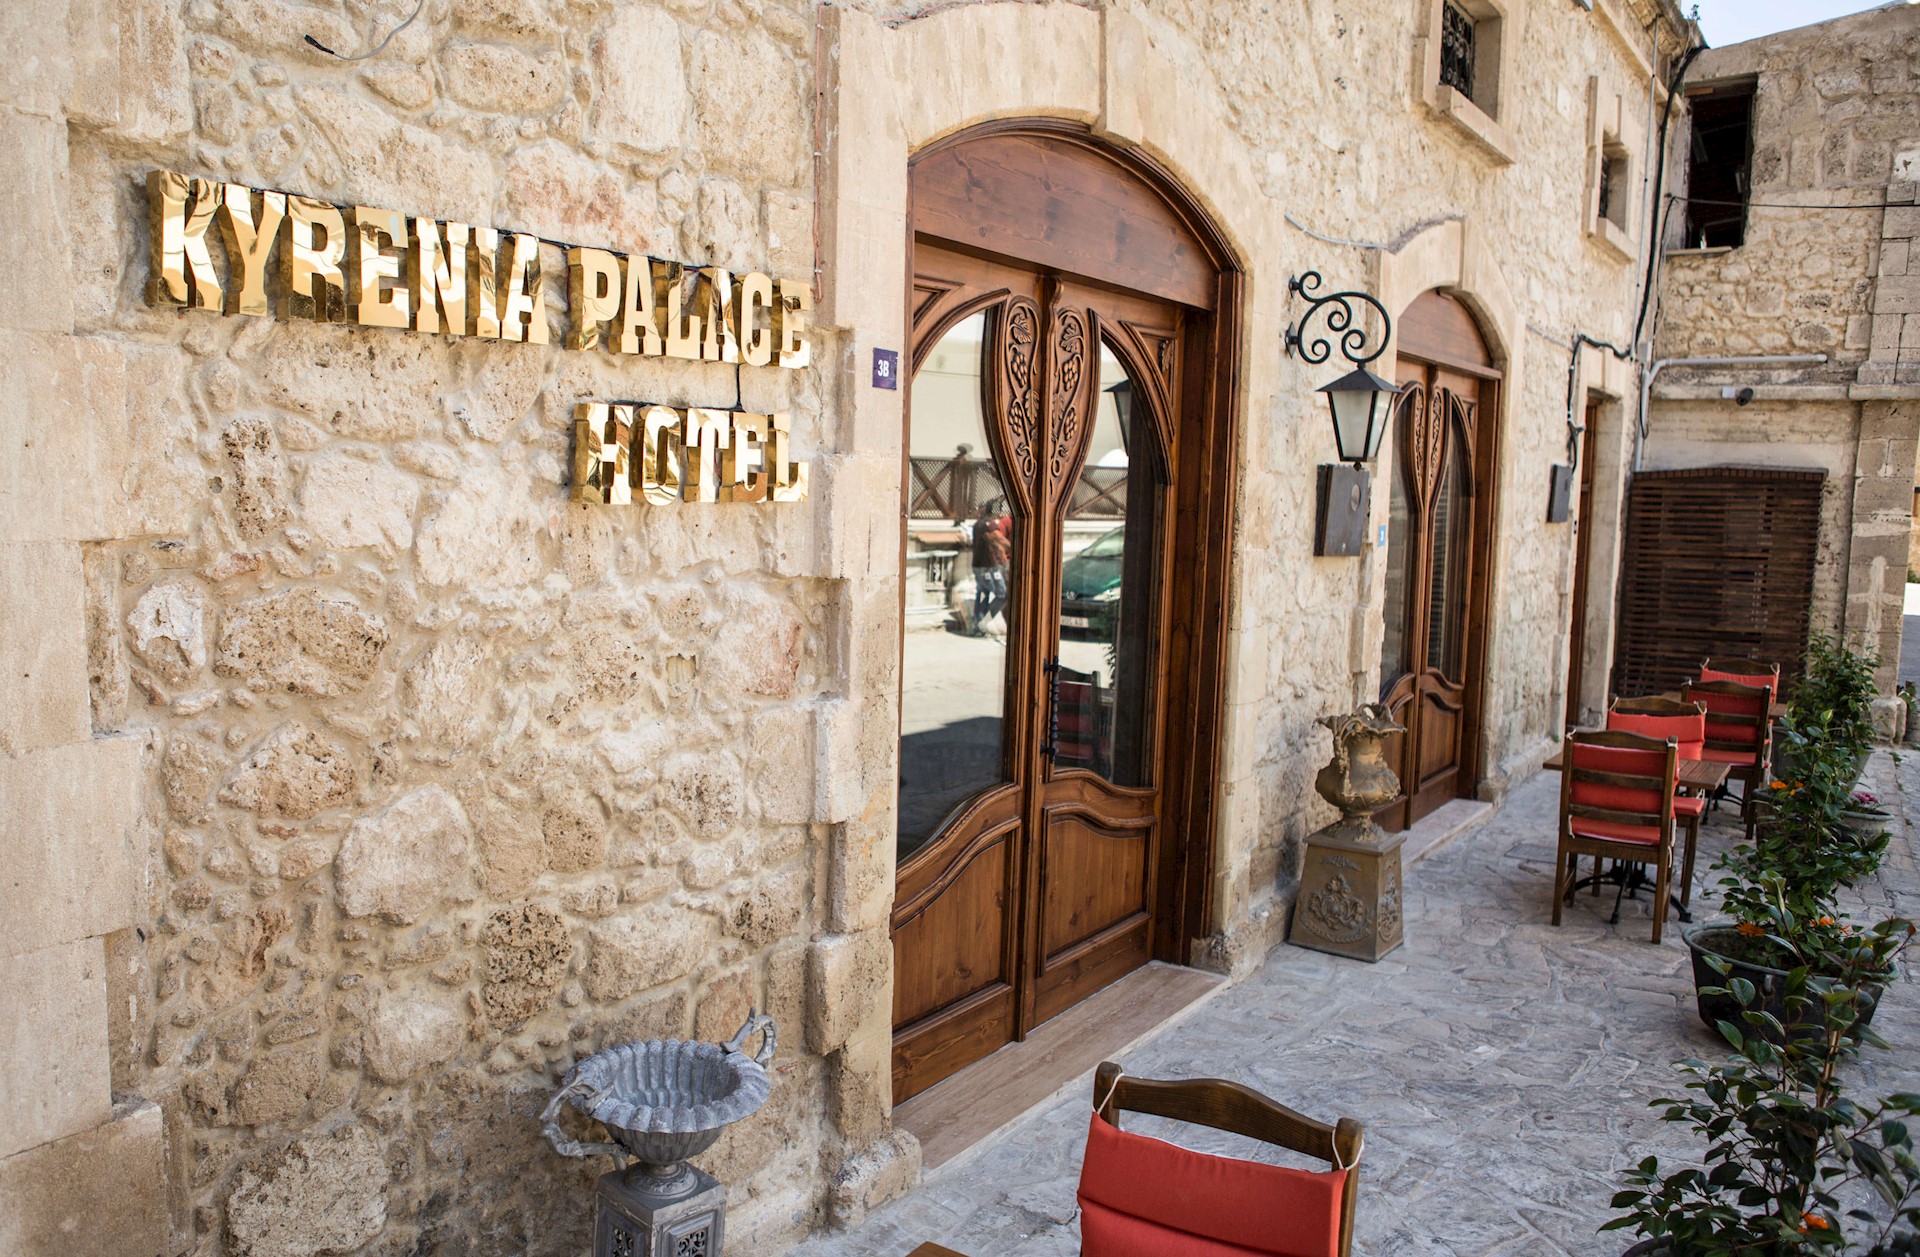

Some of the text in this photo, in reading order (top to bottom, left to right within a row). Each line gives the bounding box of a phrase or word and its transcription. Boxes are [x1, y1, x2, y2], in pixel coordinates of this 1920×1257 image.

[148, 170, 811, 369] KYRENIA PALACE
[877, 359, 890, 378] 3B
[573, 402, 810, 506] HOTEL
